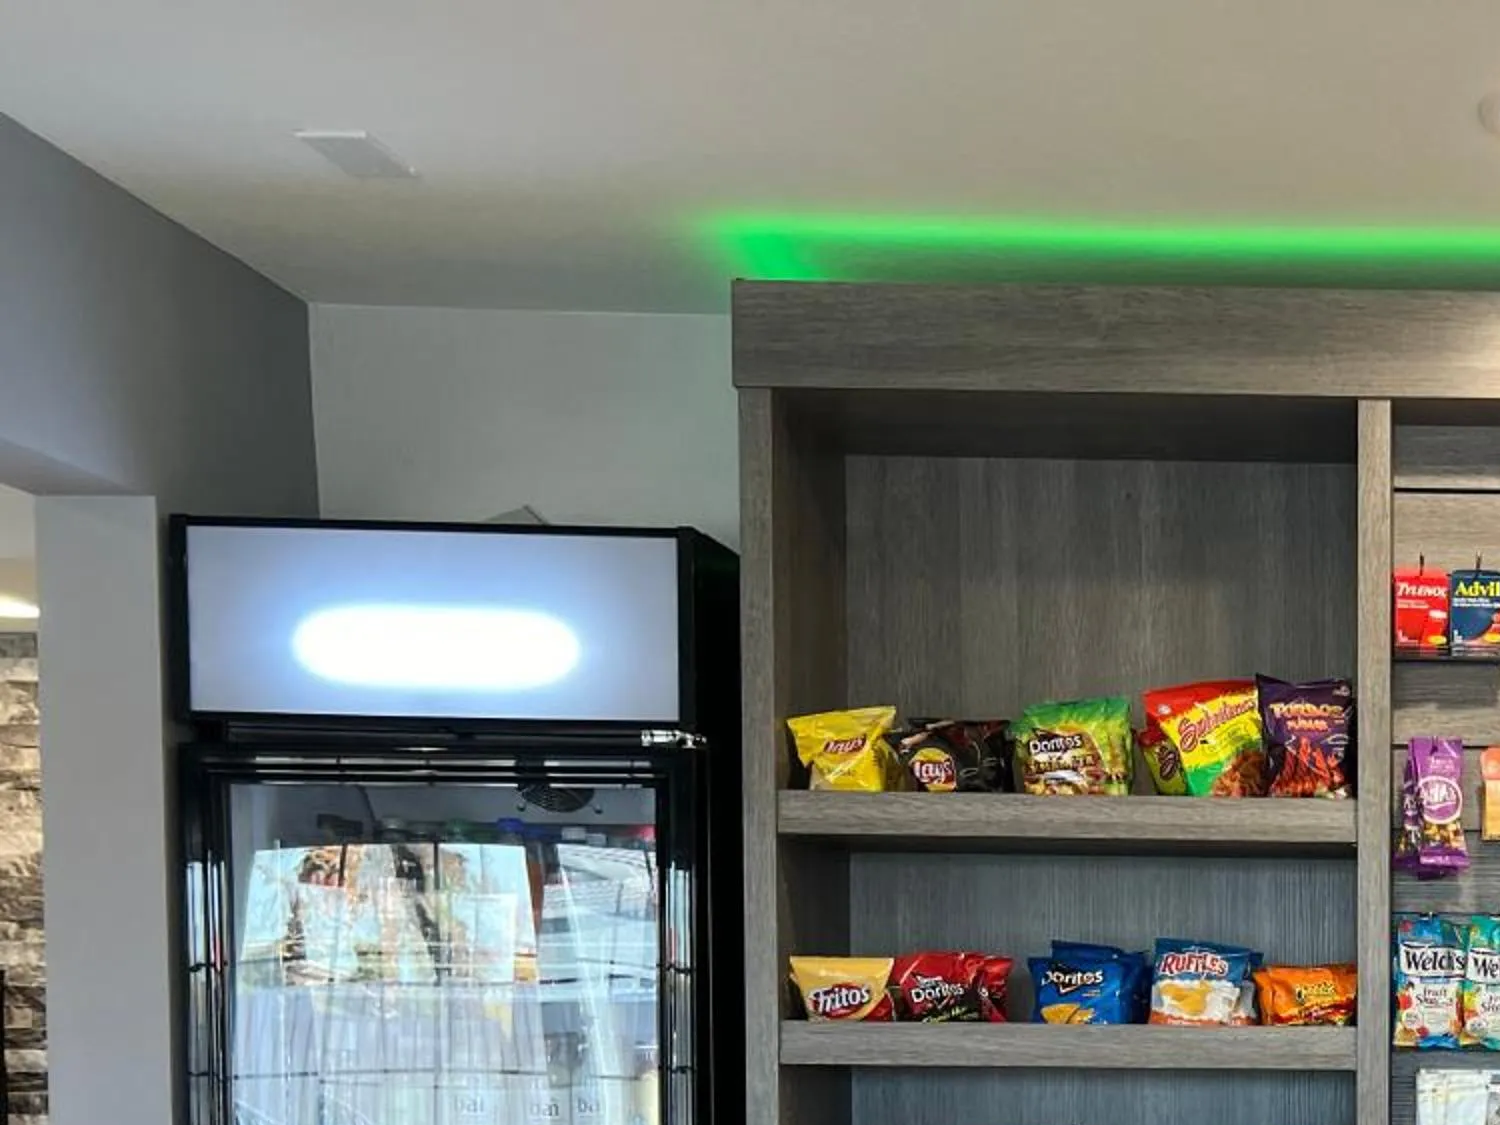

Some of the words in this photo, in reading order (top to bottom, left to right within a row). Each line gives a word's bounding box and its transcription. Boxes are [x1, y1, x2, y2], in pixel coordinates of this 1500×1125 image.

[1029, 735, 1083, 753] Doritos
[1159, 951, 1229, 977] RUFFLES
[1040, 970, 1104, 988] Doritos
[809, 985, 870, 1013] Fritos
[911, 982, 965, 1004] Doritos
